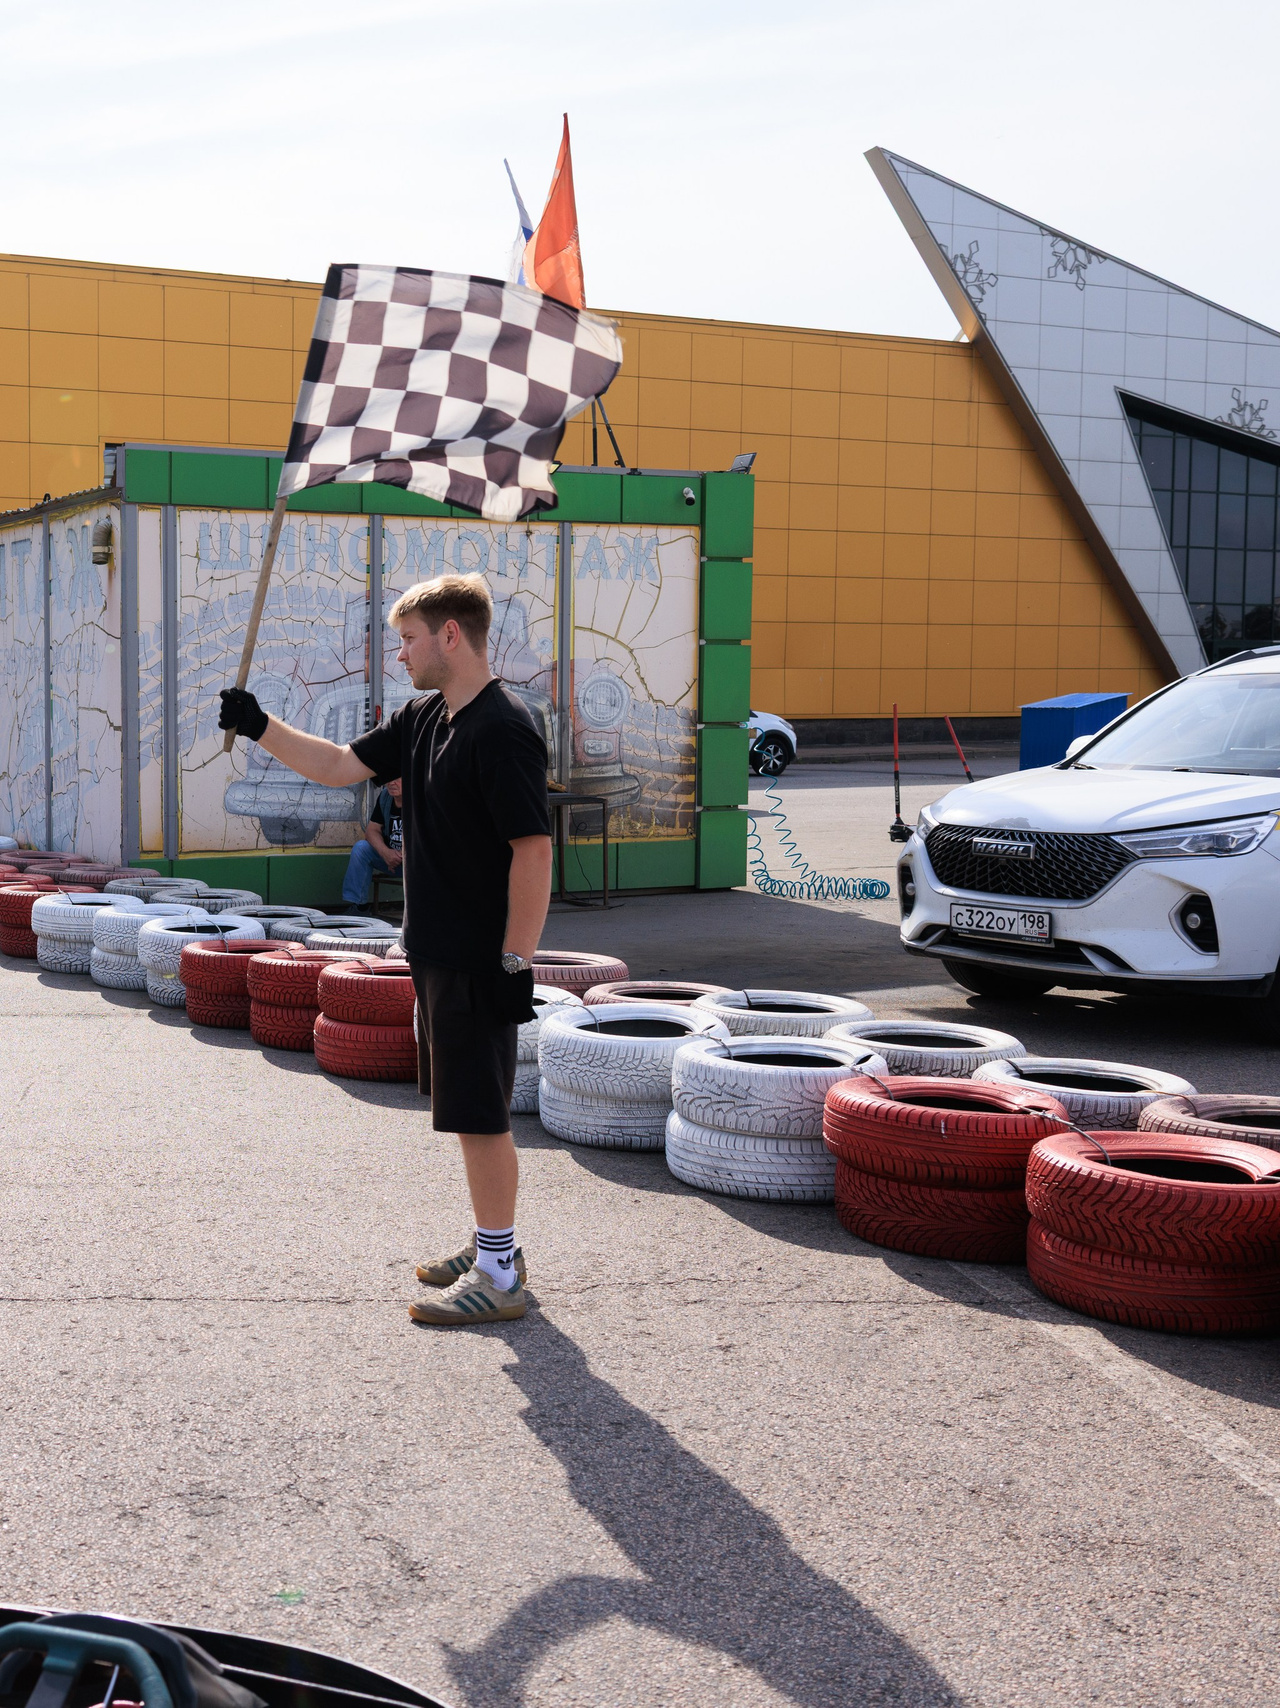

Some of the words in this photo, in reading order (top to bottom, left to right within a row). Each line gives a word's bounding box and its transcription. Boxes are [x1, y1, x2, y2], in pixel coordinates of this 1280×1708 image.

[197, 521, 659, 581] ШИНОМОНТАЖ
[975, 842, 1029, 857] HAVAL
[1020, 913, 1045, 930] 198
